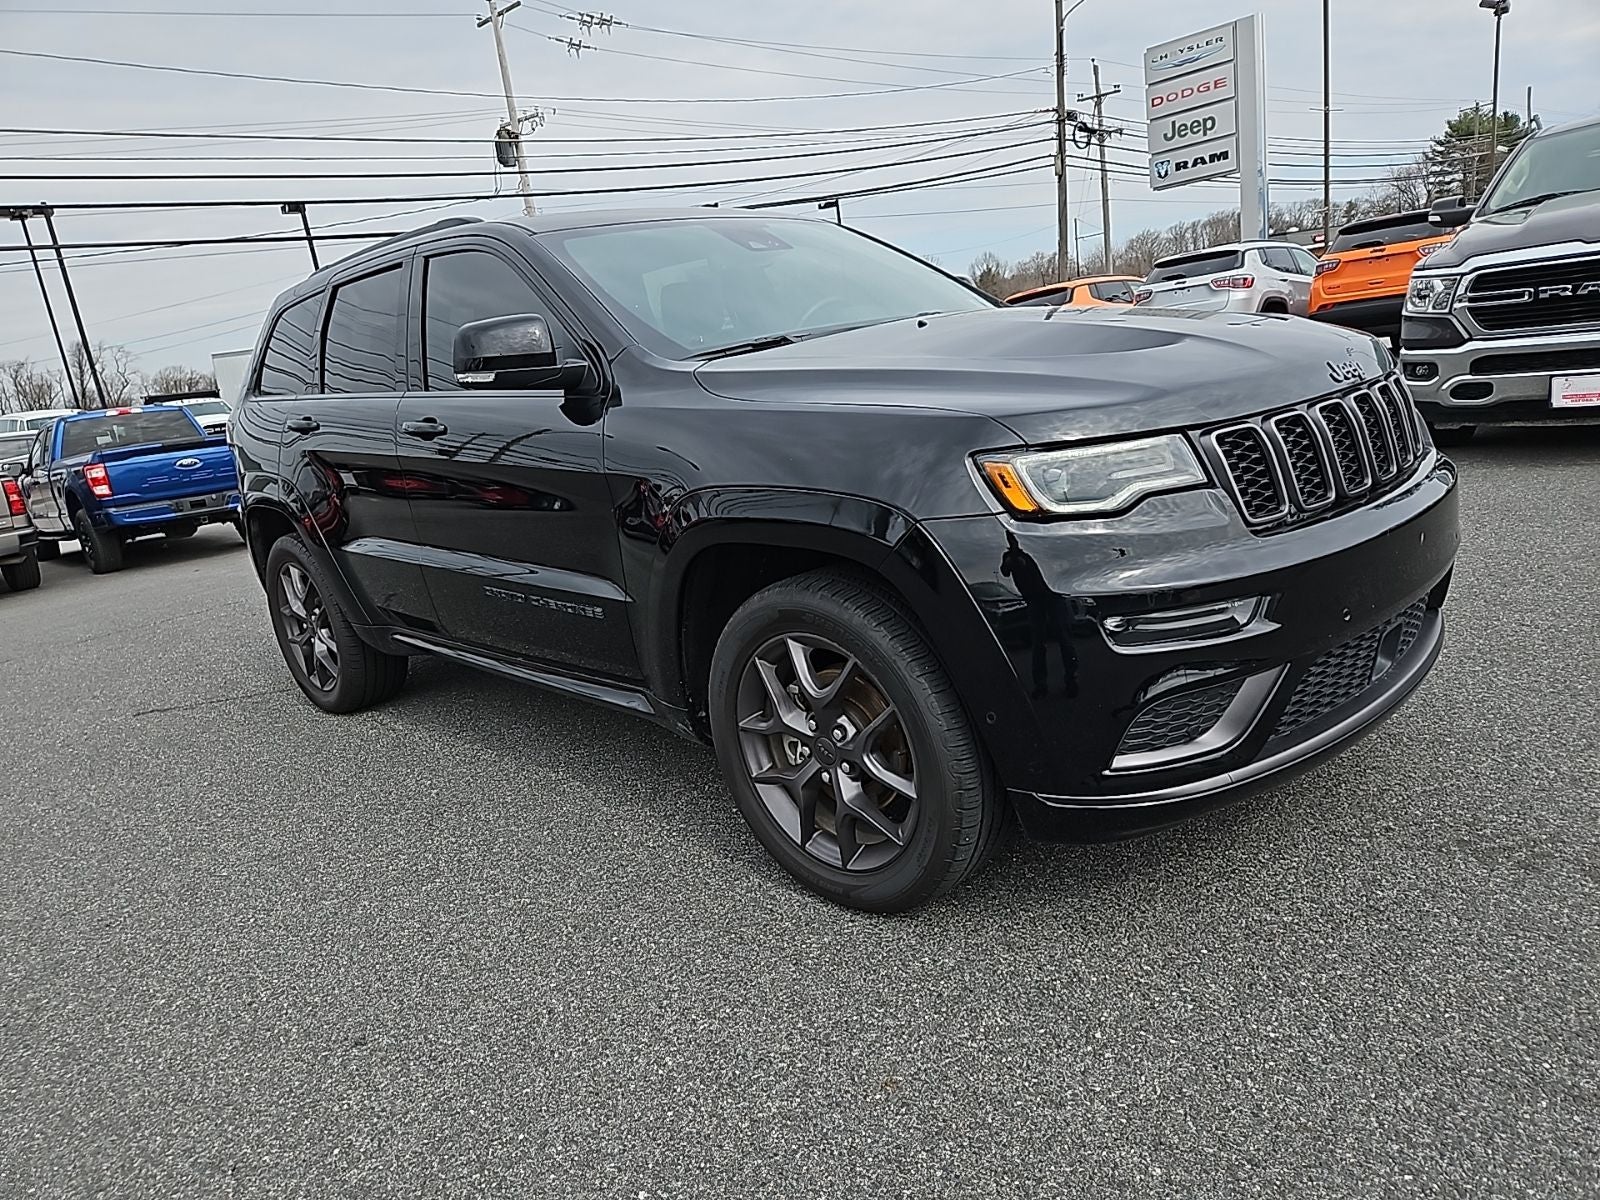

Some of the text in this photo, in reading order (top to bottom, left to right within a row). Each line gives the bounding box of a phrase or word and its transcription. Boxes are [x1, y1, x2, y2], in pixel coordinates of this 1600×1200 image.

[1151, 36, 1225, 64] CHYSLER
[1151, 77, 1228, 108] DODGE
[1163, 115, 1217, 142] Jeep
[1174, 150, 1230, 172] RAM
[1326, 361, 1366, 383] Jeep
